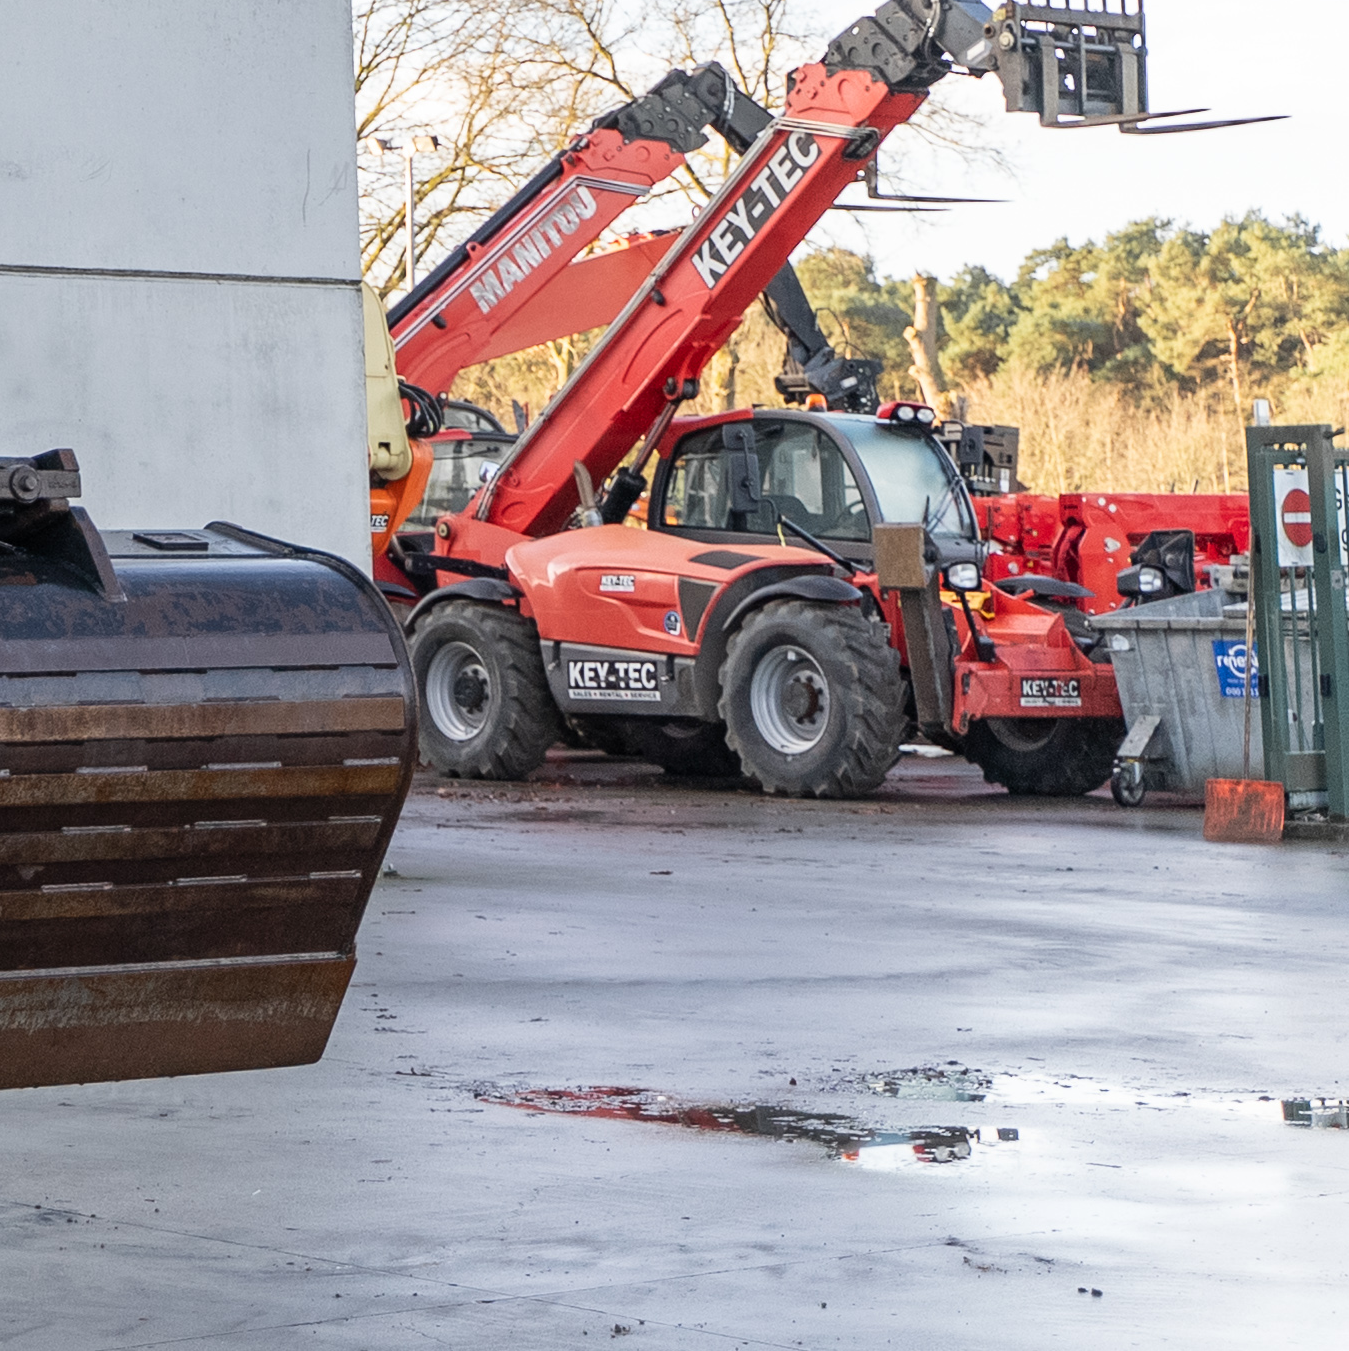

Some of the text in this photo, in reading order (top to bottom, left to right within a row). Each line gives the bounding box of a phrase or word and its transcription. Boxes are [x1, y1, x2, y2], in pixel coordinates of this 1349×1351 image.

[468, 184, 597, 314] MANITOU
[691, 130, 818, 290] KEY-TEC
[568, 661, 656, 689] KEY-TEC
